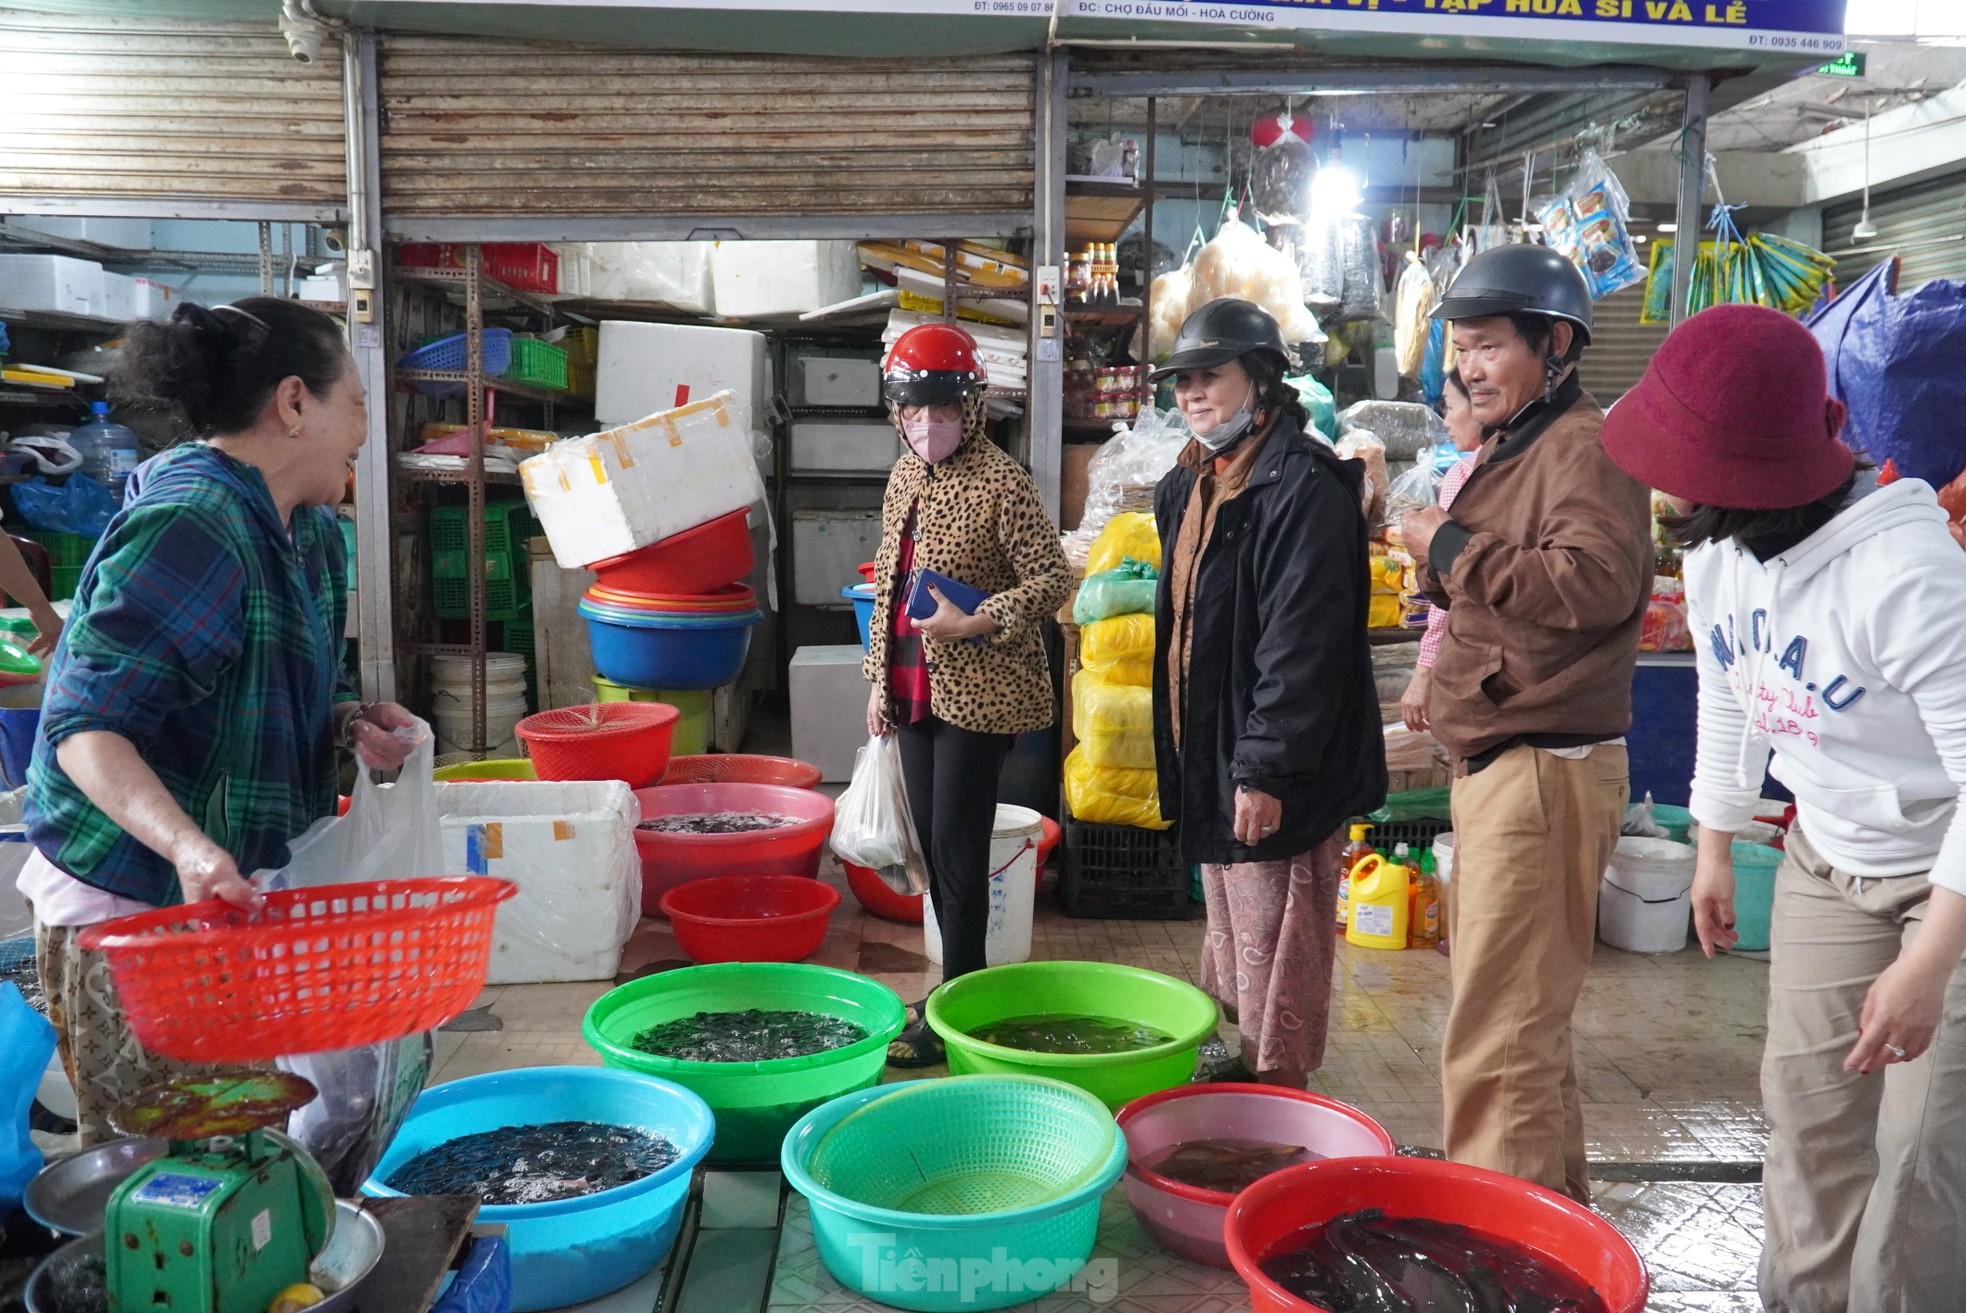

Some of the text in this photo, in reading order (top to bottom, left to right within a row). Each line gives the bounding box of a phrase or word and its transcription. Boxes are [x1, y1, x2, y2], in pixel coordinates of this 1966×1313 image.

[974, 1, 990, 11] ĐT:
[993, 2, 1015, 11] 0965
[1017, 2, 1029, 12] 09
[1031, 2, 1042, 12] 07
[1079, 2, 1100, 12] ĐC:
[1105, 3, 1132, 16] CHỢ
[1165, 4, 1188, 17] MỐI
[1200, 7, 1226, 19] HOÀ
[1230, 9, 1275, 21] CƯỜNG
[1705, 0, 1747, 24] LẺ
[1749, 35, 1842, 50] ĐT: 0935 446 909
